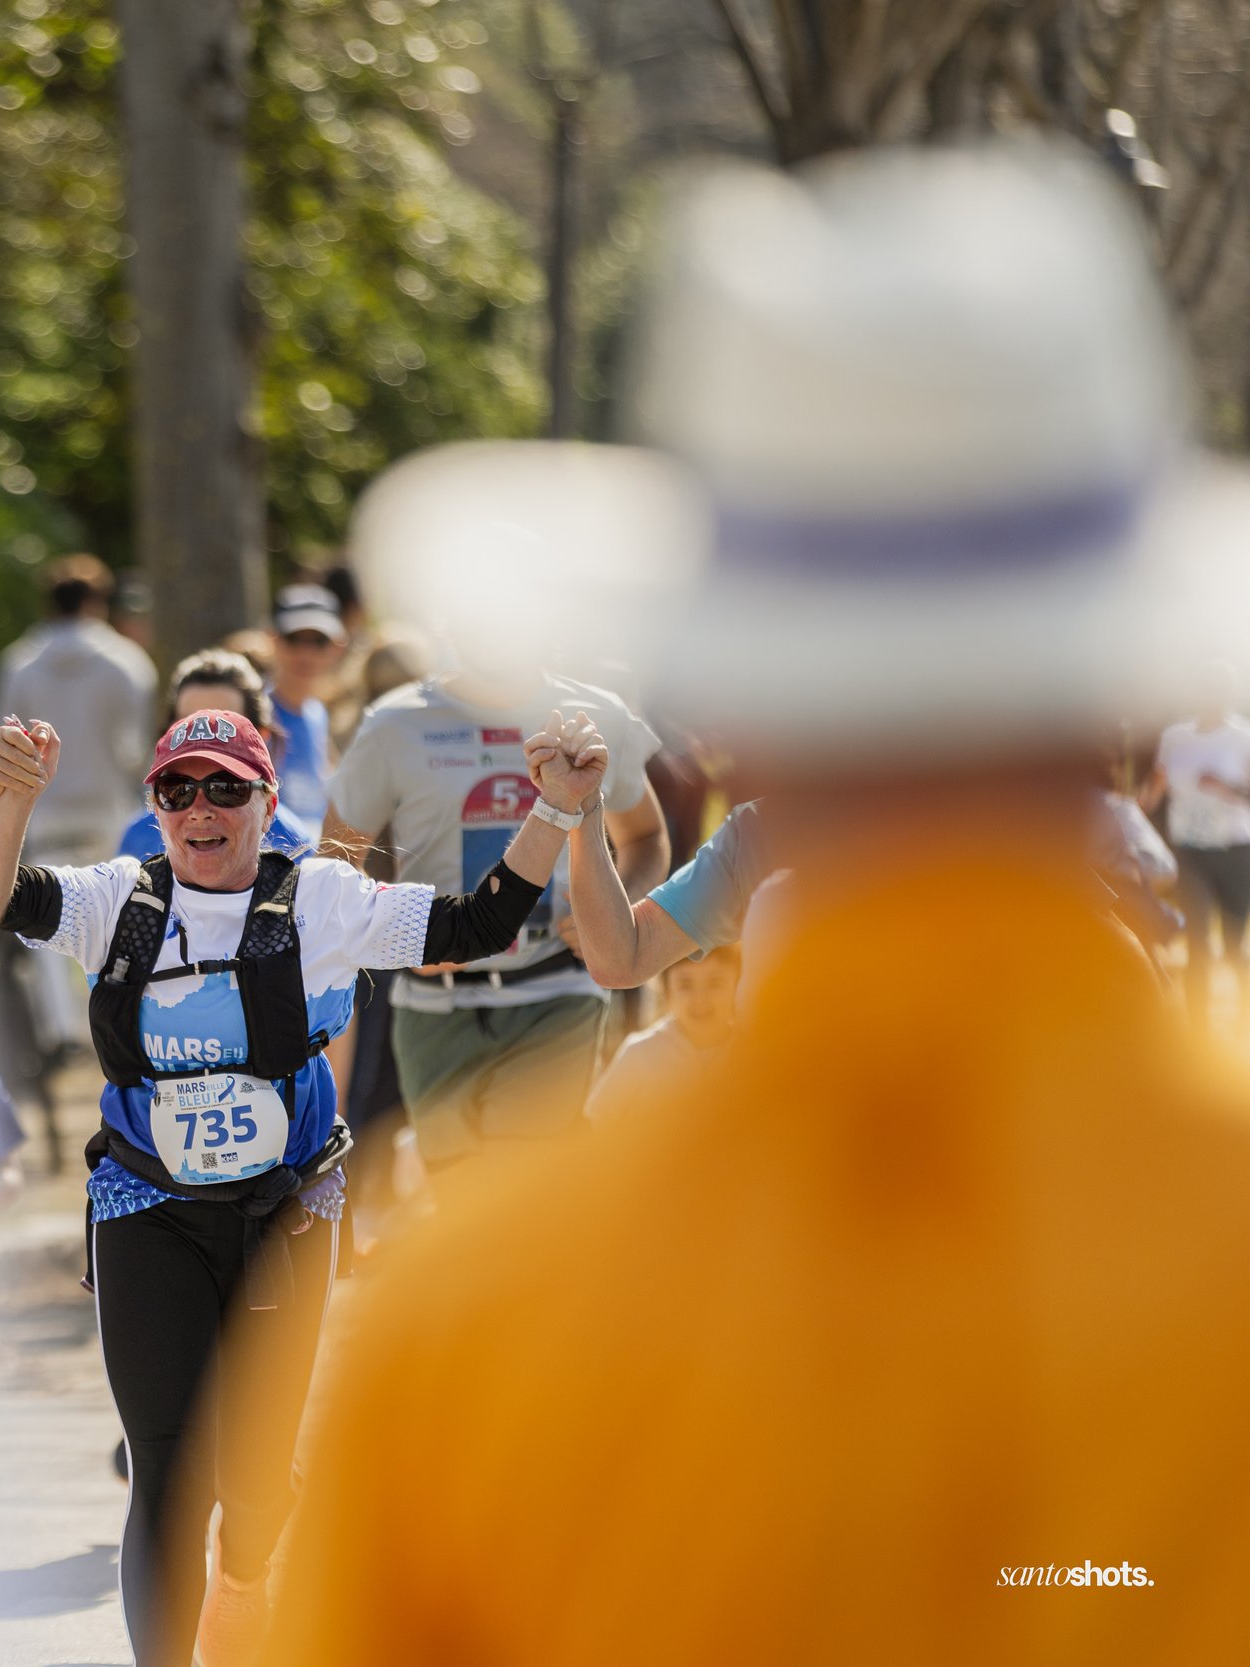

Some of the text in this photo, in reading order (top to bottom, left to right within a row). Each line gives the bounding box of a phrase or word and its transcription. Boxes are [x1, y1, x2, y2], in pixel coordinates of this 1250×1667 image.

[170, 716, 237, 751] GAP
[492, 778, 520, 815] 5
[176, 1081, 224, 1096] MARSEILLE
[175, 1104, 258, 1150] 735
